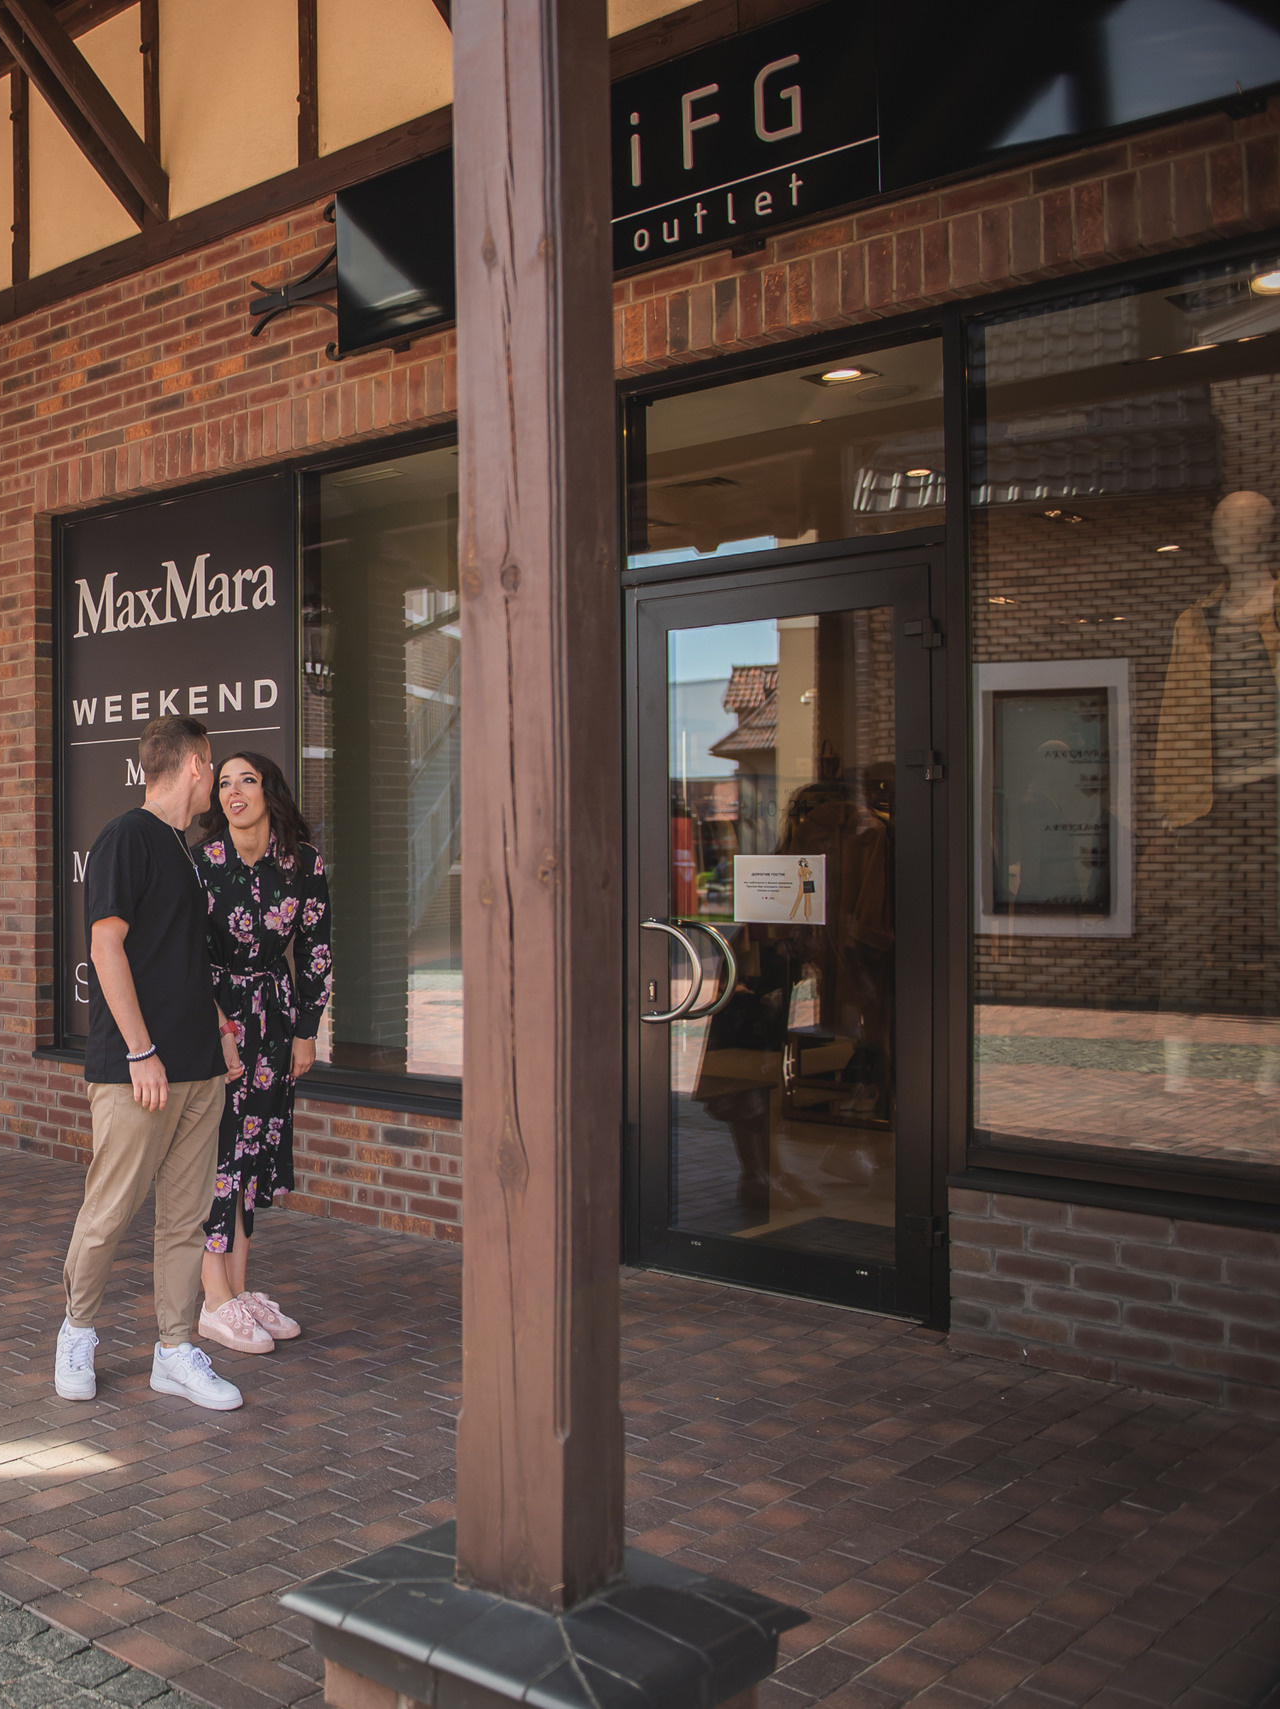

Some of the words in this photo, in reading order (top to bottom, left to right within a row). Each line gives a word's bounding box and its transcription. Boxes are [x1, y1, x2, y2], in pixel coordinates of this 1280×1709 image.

[633, 172, 804, 252] outlet
[73, 552, 276, 639] MaxMara
[72, 678, 278, 726] WEEKEND
